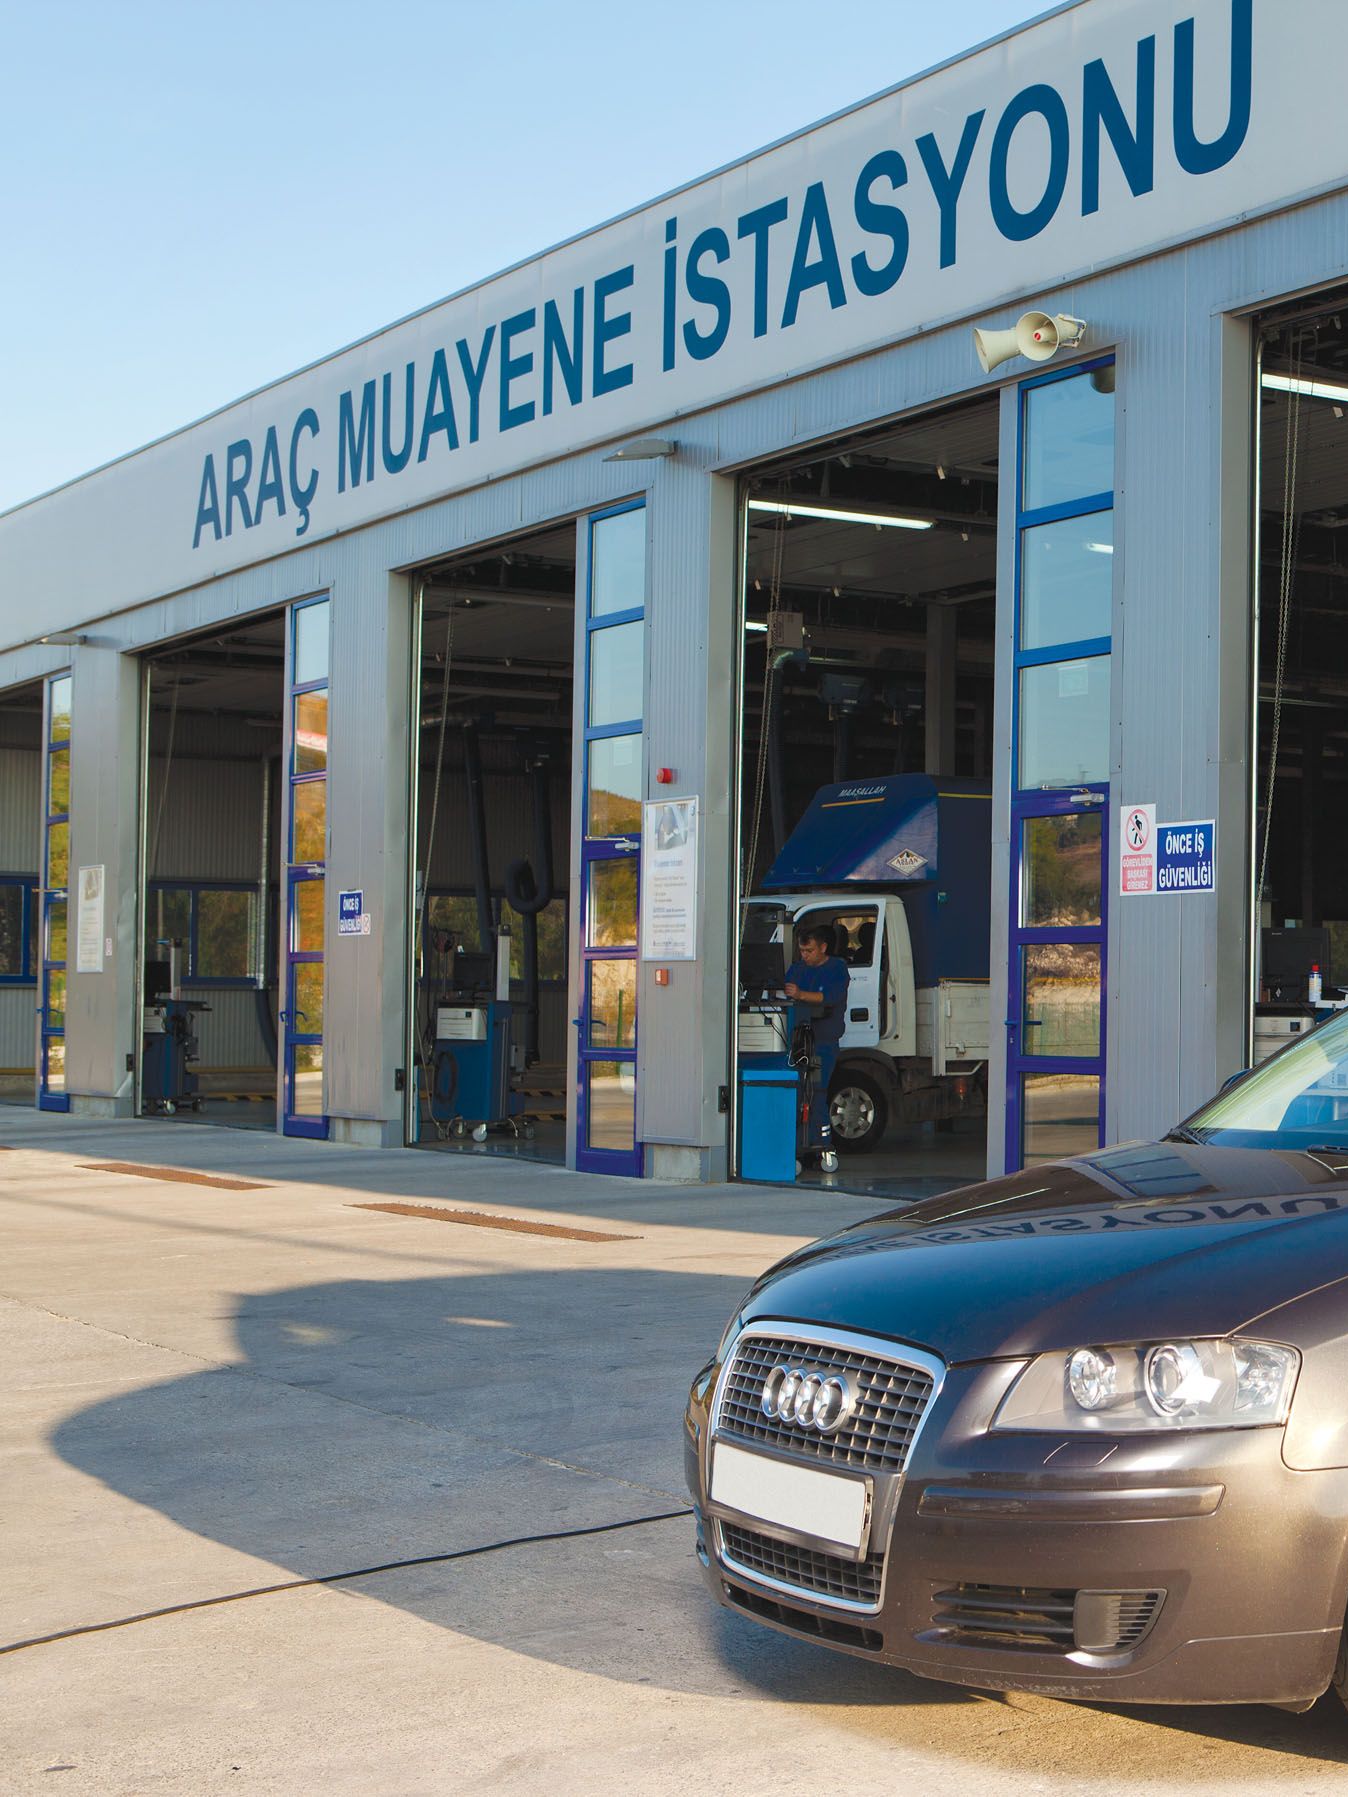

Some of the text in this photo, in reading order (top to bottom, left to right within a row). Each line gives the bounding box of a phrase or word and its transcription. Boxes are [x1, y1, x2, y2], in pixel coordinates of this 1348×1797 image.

[193, 0, 1253, 549] ARAÇ MUAYENE İSTASYONU
[1165, 828, 1205, 857] ÖNCE İŞ
[1158, 861, 1212, 888] GÜVENLİĞİ
